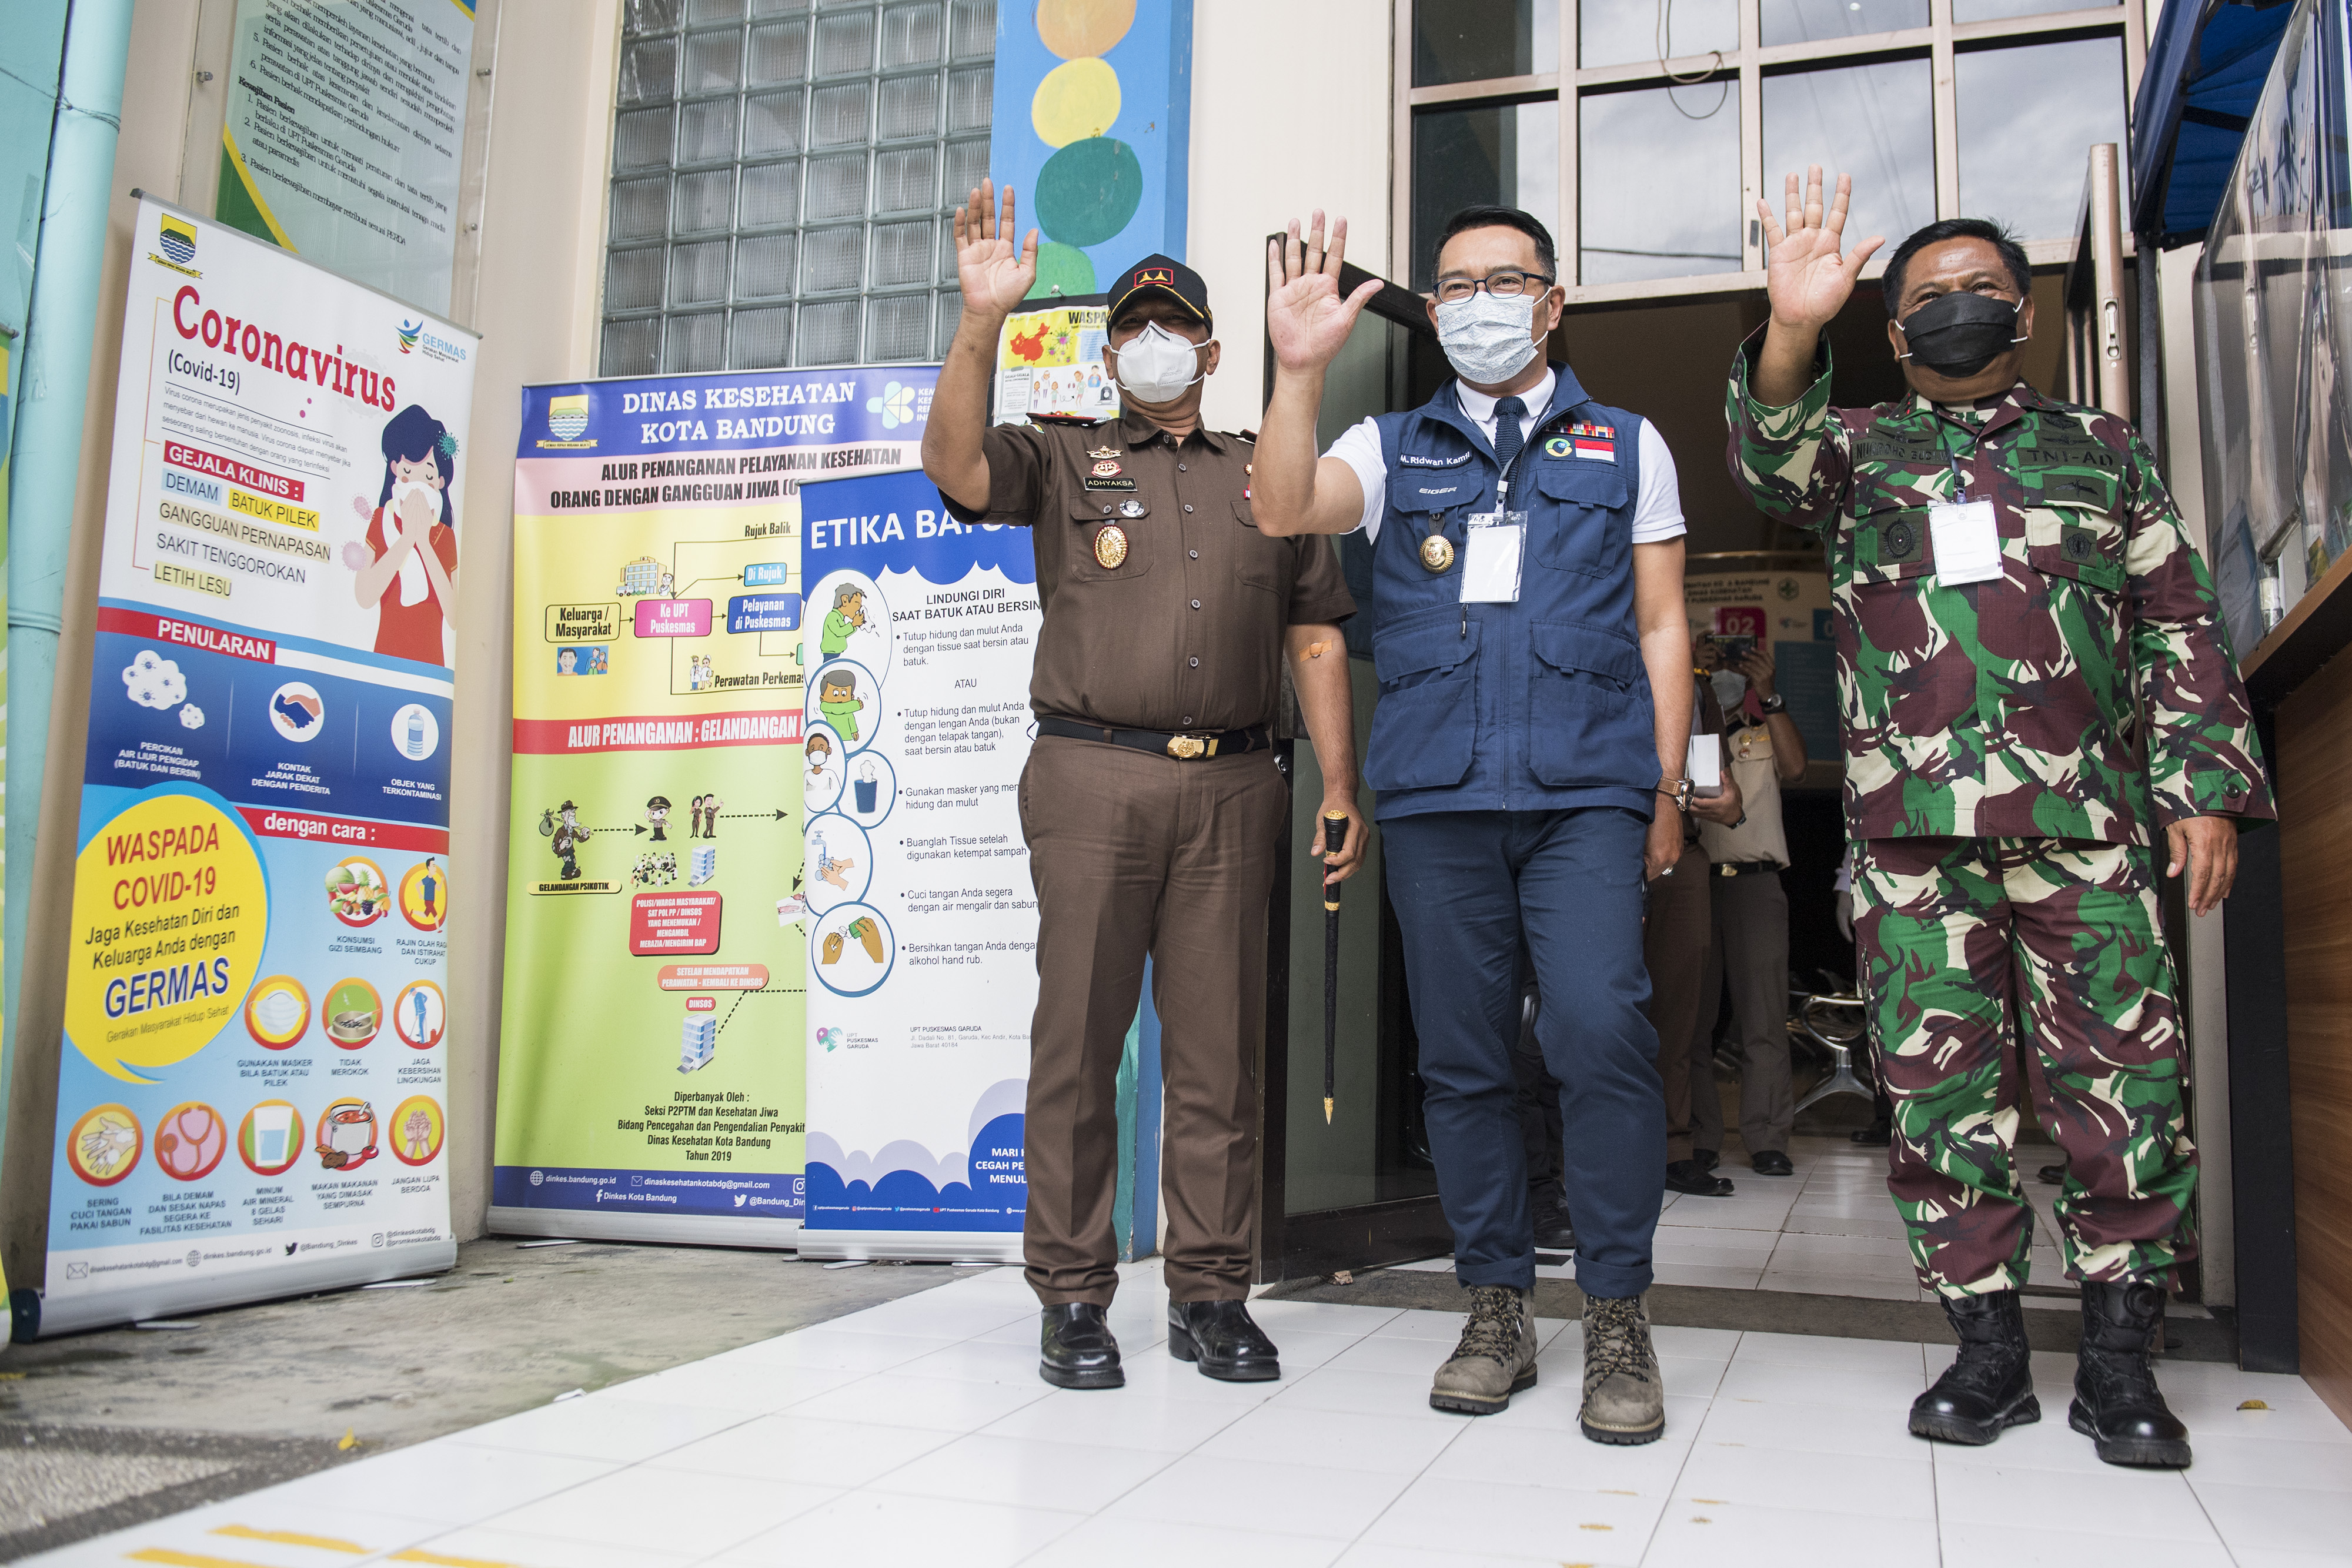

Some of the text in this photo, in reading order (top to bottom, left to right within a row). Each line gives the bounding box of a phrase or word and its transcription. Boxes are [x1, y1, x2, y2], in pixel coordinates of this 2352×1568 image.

[173, 285, 395, 412] Coronavirus
[422, 333, 466, 360] GERMAS
[422, 349, 433, 357] Hidup
[422, 344, 459, 363] Gerakan Masyarakat
[169, 349, 239, 395] (Covid-19)
[623, 381, 856, 413] DINAS KESEHATAN
[641, 413, 835, 443] KOTA BANDUNG
[1400, 451, 1469, 466] M. Ridwan Kamil
[1855, 443, 1906, 460] NUGROHO
[169, 446, 236, 479] GEJALA
[239, 466, 289, 494] KLINIS
[601, 449, 900, 481] ALUR PENANGANAN PELAYANAN KESEHATAN
[166, 473, 218, 500] DEMAM
[550, 480, 779, 508] ORANG DENGAN GANGGUAN JIWA
[232, 492, 315, 527] BATUK PILEK
[160, 503, 330, 560] GANGGUAN PERNAPASAN
[744, 521, 790, 538] Rujuk Balik
[811, 513, 904, 549] ETIKA
[157, 533, 305, 583] SAKIT TENGGOROKAN
[155, 564, 230, 596] LETIH LESU
[747, 565, 782, 581] Di Rujuk
[927, 588, 1004, 604] LINDUNGI DIRI
[660, 603, 689, 617] Ke UPT
[743, 599, 784, 613] Pelayanan
[892, 600, 1041, 621] SAAT BATUK ATAU BERSIN
[560, 607, 602, 622] Keluarga
[556, 621, 611, 638] Masyarakat
[650, 621, 695, 633] Puskesmas
[735, 616, 791, 630] di Puskesmas
[1725, 616, 1754, 636] 02
[158, 619, 269, 660] PENULARAN
[903, 623, 1023, 641] Tutup hidung dan mulut Anda
[903, 637, 1028, 654] dengan tissue saat bersin atau
[903, 656, 928, 666] batuk.
[954, 678, 977, 688] ATAU
[567, 725, 600, 747] ALUR
[602, 721, 693, 745] PENANGANAN
[701, 716, 797, 742] GELANDANGAN
[278, 763, 311, 773] KONTAK
[265, 771, 320, 784] JARAK DEKAT
[391, 778, 435, 790] OBJEK YANG
[252, 778, 330, 794] DENGAN PENDERITA
[382, 786, 441, 800] TERKONTAMINASI
[264, 813, 327, 837] dengan
[332, 824, 366, 840] cara
[108, 823, 219, 865] WASPADA
[907, 834, 1008, 848] Buanglah Tissue setelah
[907, 846, 1026, 861] digunakan ketempat sampah
[113, 866, 215, 910] COVID-19
[539, 882, 609, 891] GELANDANGAN PSIKOTIK
[85, 905, 239, 945] Jaga Kesehatan Diri dan
[337, 935, 374, 944] KONSUMSI
[93, 931, 235, 969] Keluarga Anda dengan
[345, 945, 382, 954] SEIMBANG
[105, 957, 229, 1017] GERMAS
[689, 999, 712, 1008] DINSOS
[644, 1105, 778, 1117] Seksi P2PTM dan Kesehatan Jiwa
[686, 1150, 731, 1161] Tahun 2019
[991, 1148, 1018, 1156] MARI
[975, 1161, 1009, 1169] CEGAH
[546, 1175, 616, 1185] dinkes.bandung.go.id
[644, 1178, 770, 1189] dinaskesehatankotabdg@gmail.com
[87, 1198, 119, 1208] SERING
[604, 1192, 677, 1203] Dinkes Kota Bandung
[71, 1208, 131, 1220] CUCI TANGAN
[70, 1219, 131, 1231] PAKAI SABUN
